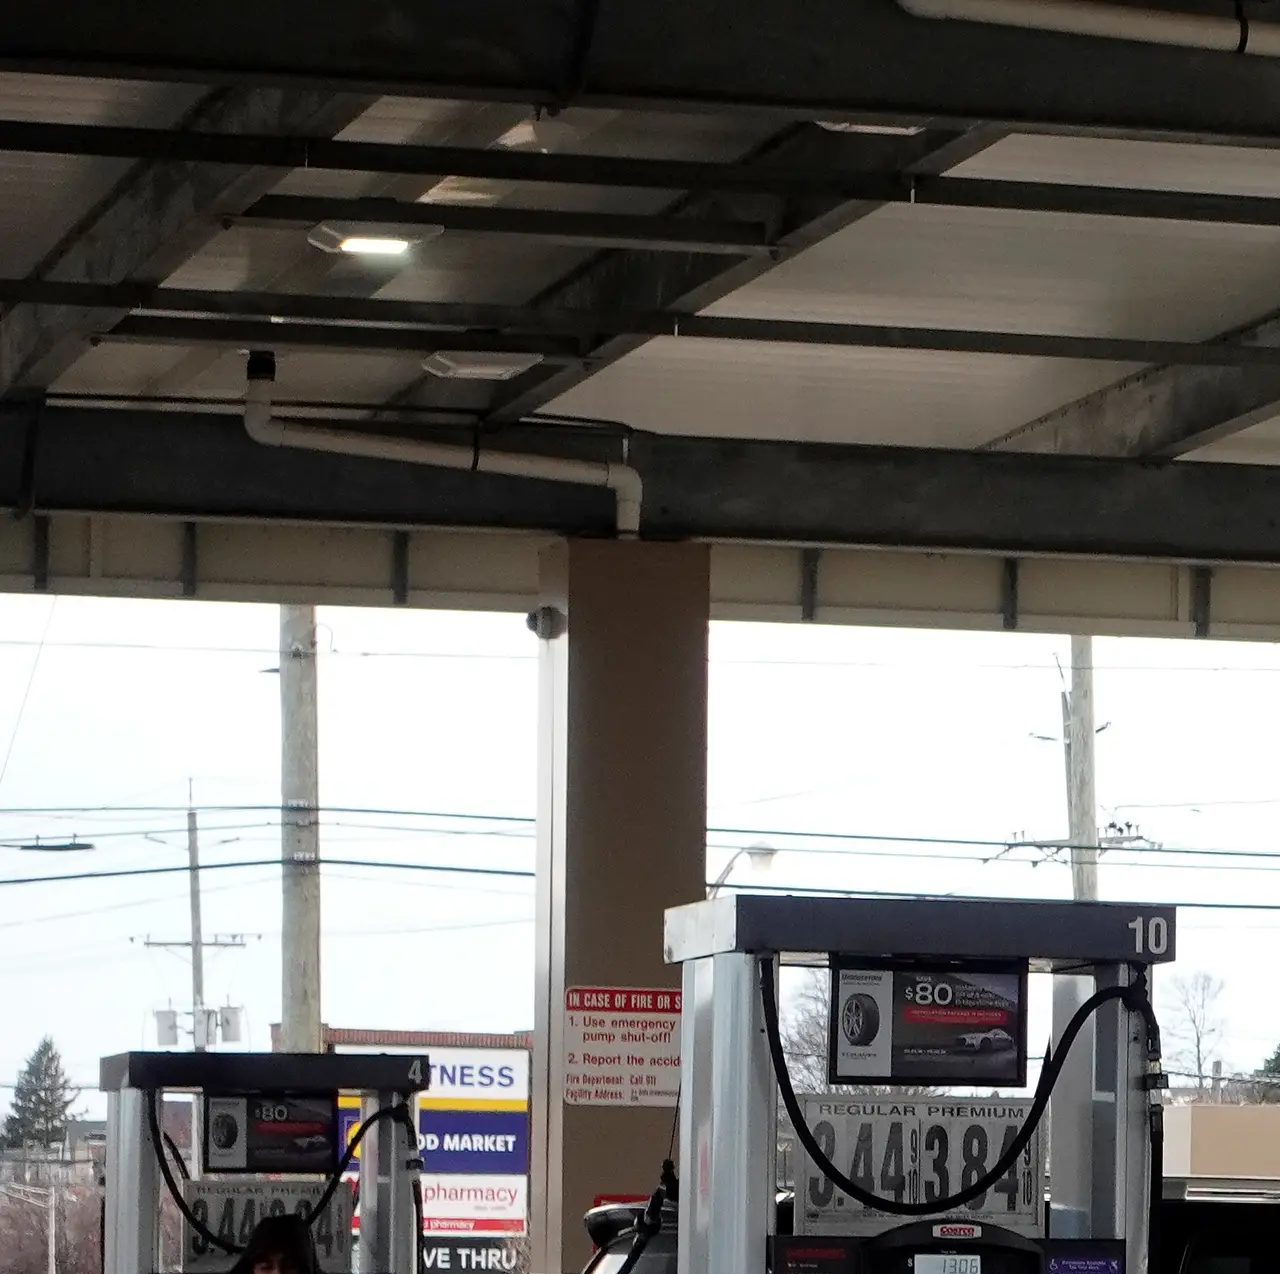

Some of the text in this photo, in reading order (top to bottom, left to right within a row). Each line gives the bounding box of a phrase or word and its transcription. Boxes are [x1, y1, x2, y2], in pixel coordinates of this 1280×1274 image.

[1128, 915, 1168, 955] 10
[568, 992, 580, 1007] IN
[584, 993, 610, 1007] CASE
[615, 994, 628, 1008] OF
[631, 994, 652, 1009] FIRE
[657, 995, 670, 1009] OR
[905, 983, 953, 1005] $80
[569, 1016, 676, 1032] 1. Use emergency
[583, 1031, 671, 1044] pump shut-off!
[568, 1052, 578, 1064] 2.
[583, 1053, 621, 1067] Report
[627, 1054, 645, 1065] the
[408, 1060, 422, 1084] 4
[566, 1074, 579, 1085] Fire
[819, 1103, 1025, 1119] REGULAR PREMIUM
[443, 1134, 517, 1151] MARKET
[424, 1183, 518, 1204] pharmacy
[457, 1248, 517, 1269] THRU
